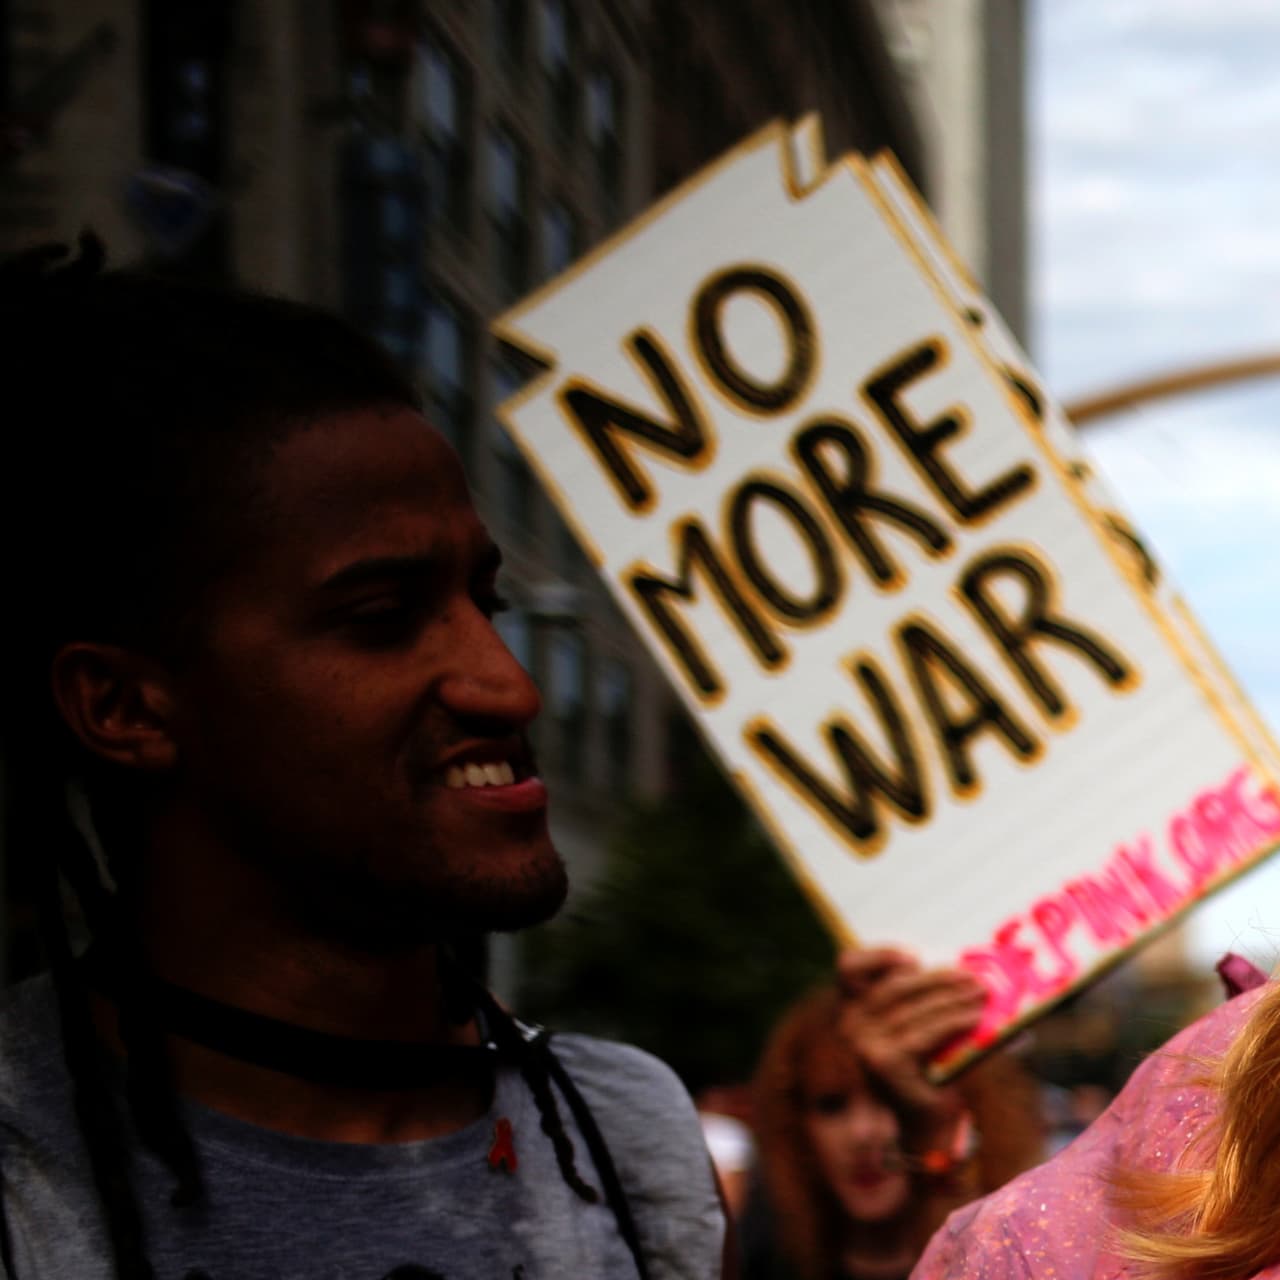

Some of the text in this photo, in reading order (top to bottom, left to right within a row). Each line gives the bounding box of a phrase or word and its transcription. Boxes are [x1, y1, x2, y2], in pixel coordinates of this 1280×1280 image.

[561, 267, 817, 511] NO
[628, 339, 1036, 701] MORE
[749, 548, 1137, 853] WAR
